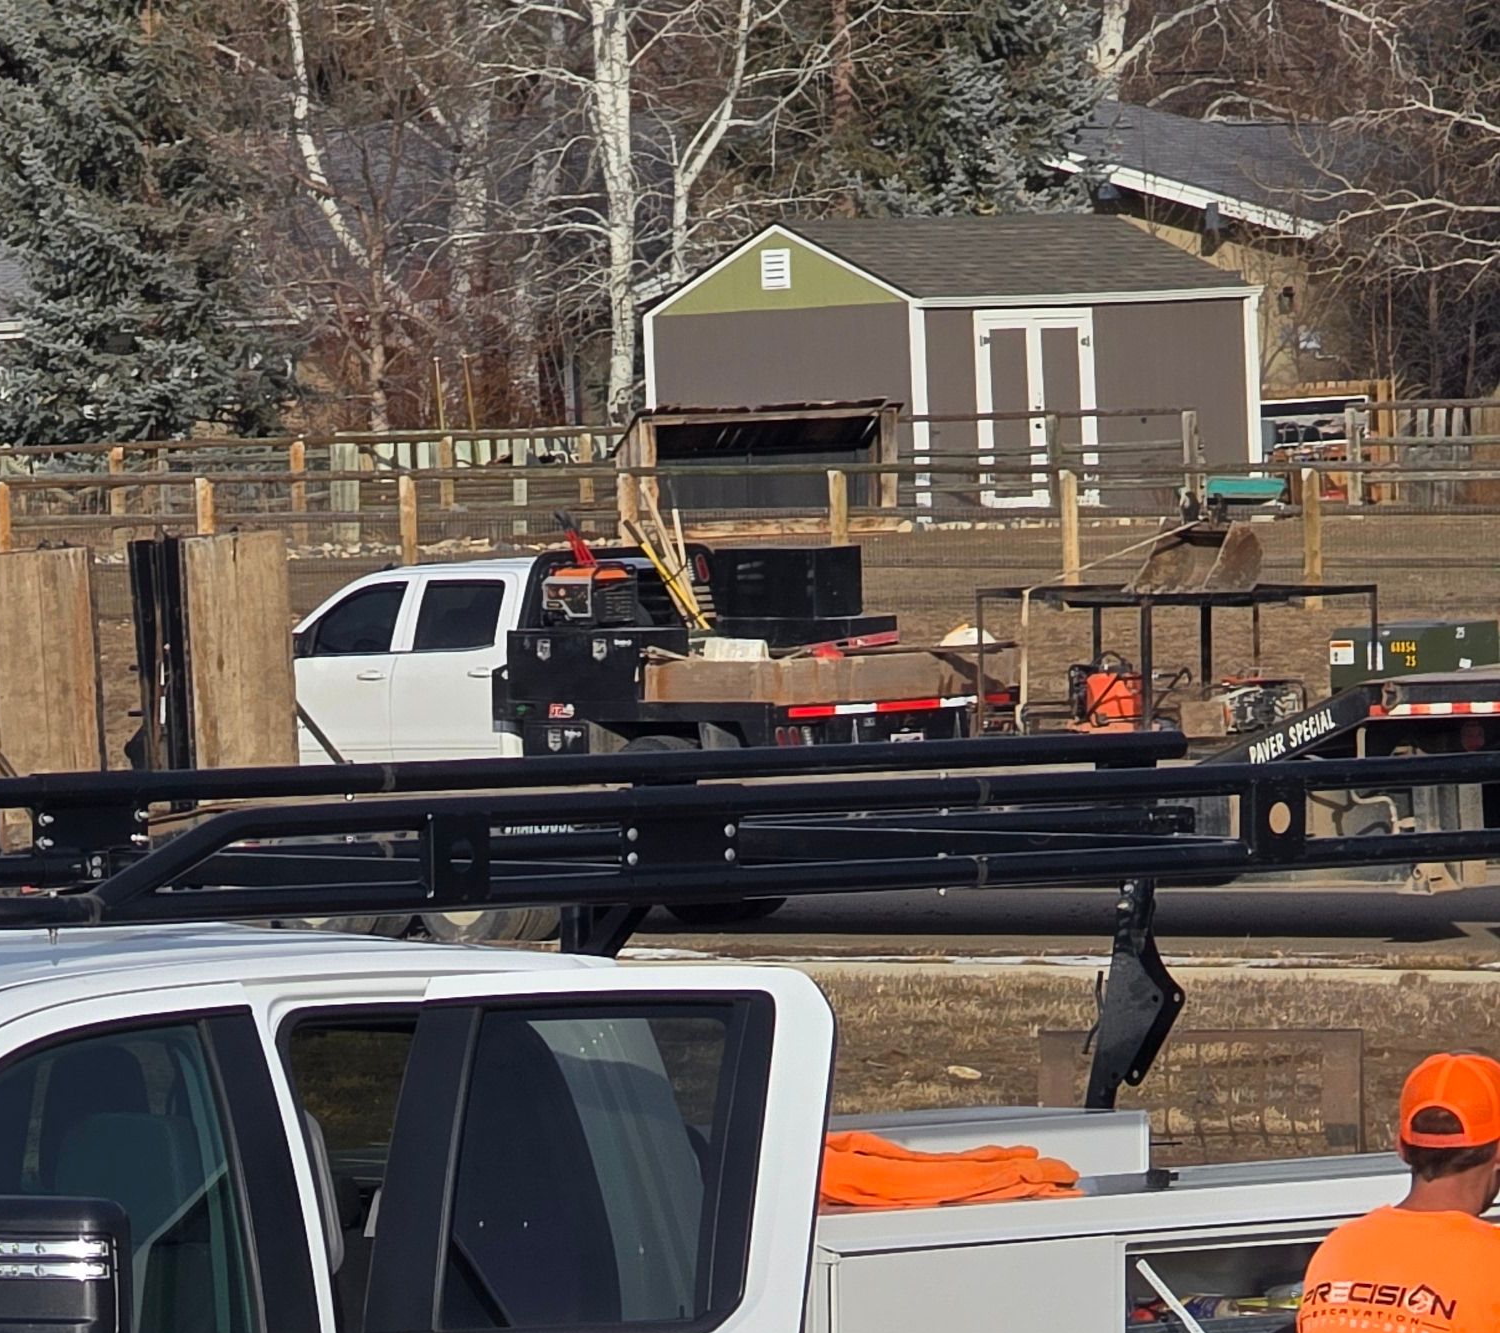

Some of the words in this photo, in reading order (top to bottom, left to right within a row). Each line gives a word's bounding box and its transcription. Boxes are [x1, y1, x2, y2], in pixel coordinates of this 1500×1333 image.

[1248, 733, 1286, 764] PAVER
[1288, 708, 1336, 748] SPECIAL
[1303, 1282, 1457, 1320] PRECISION
[1312, 1308, 1420, 1325] EXCAVATION
